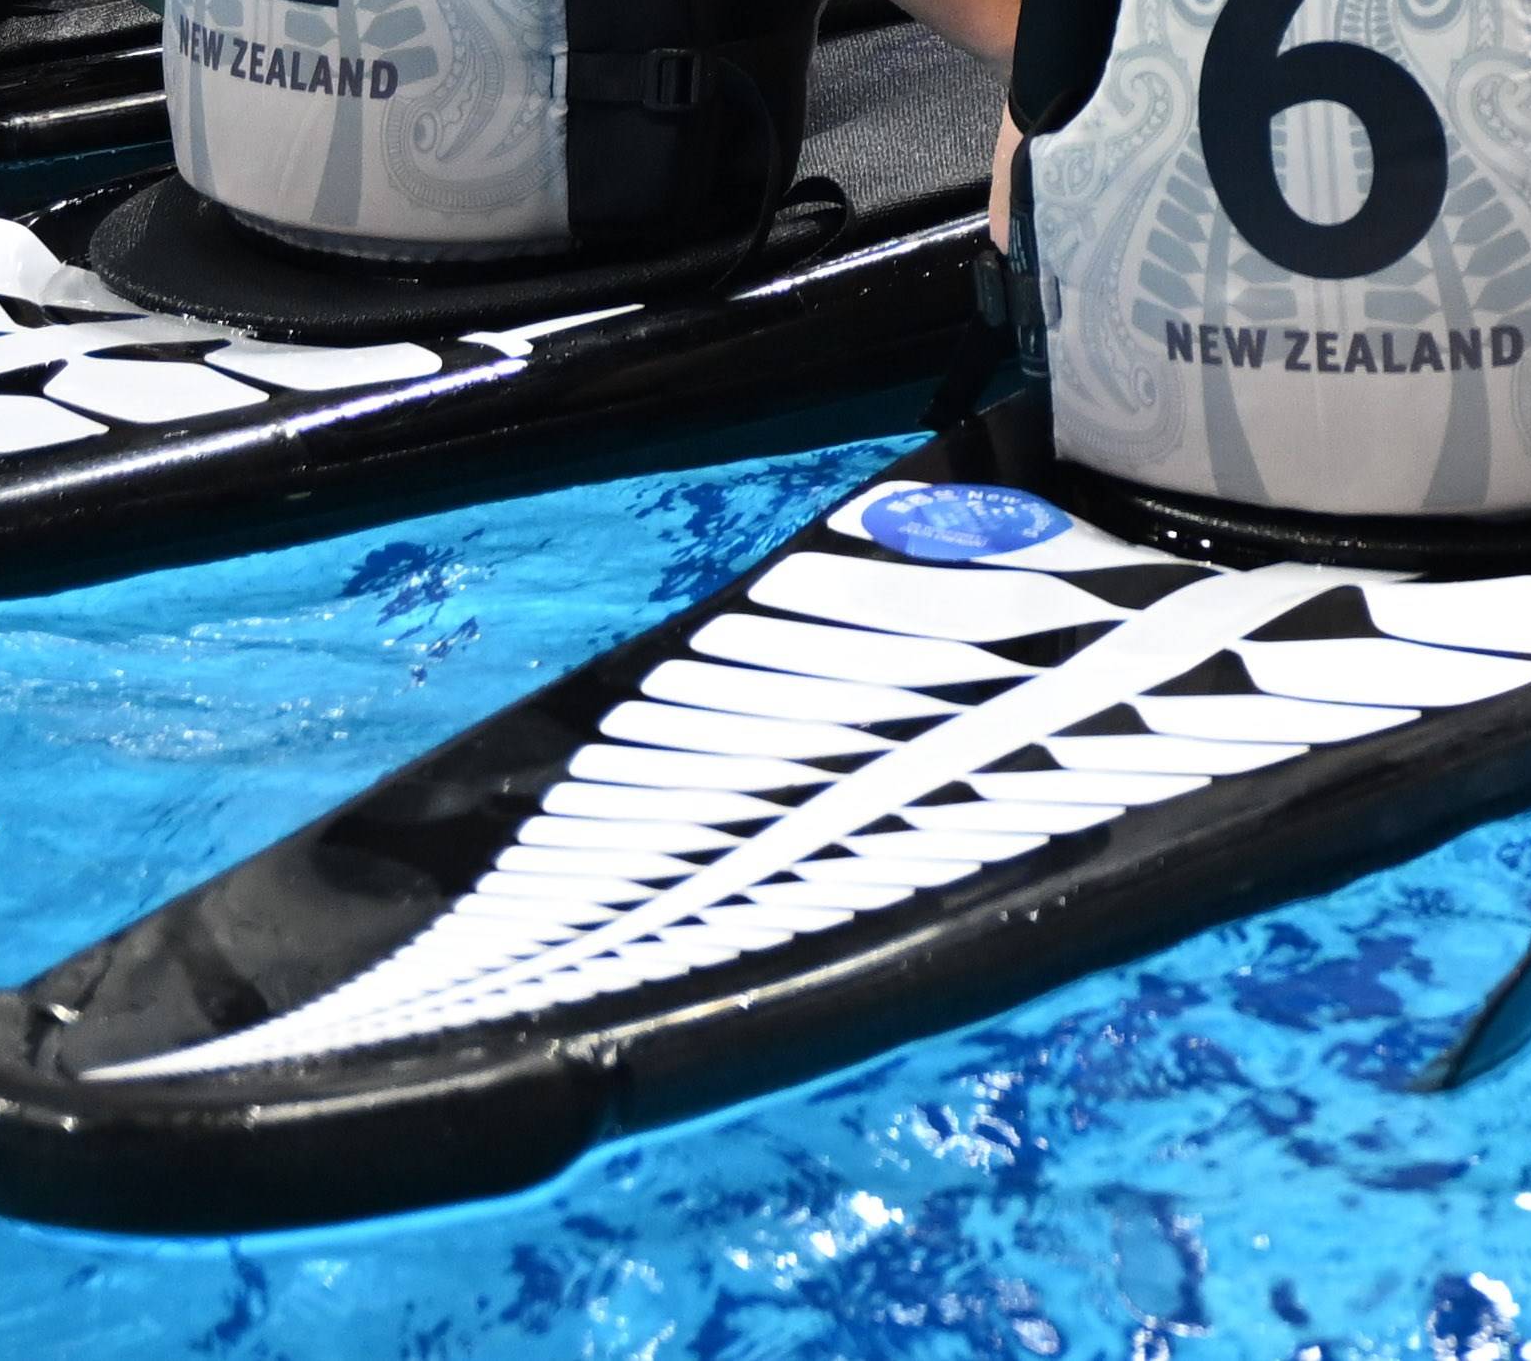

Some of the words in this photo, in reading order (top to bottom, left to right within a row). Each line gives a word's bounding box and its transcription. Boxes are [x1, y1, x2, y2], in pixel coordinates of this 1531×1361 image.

[178, 15, 222, 68] NEW
[230, 36, 399, 101] ZEALAND
[1165, 321, 1268, 368] NEW
[1284, 325, 1525, 374] ZEALAND
